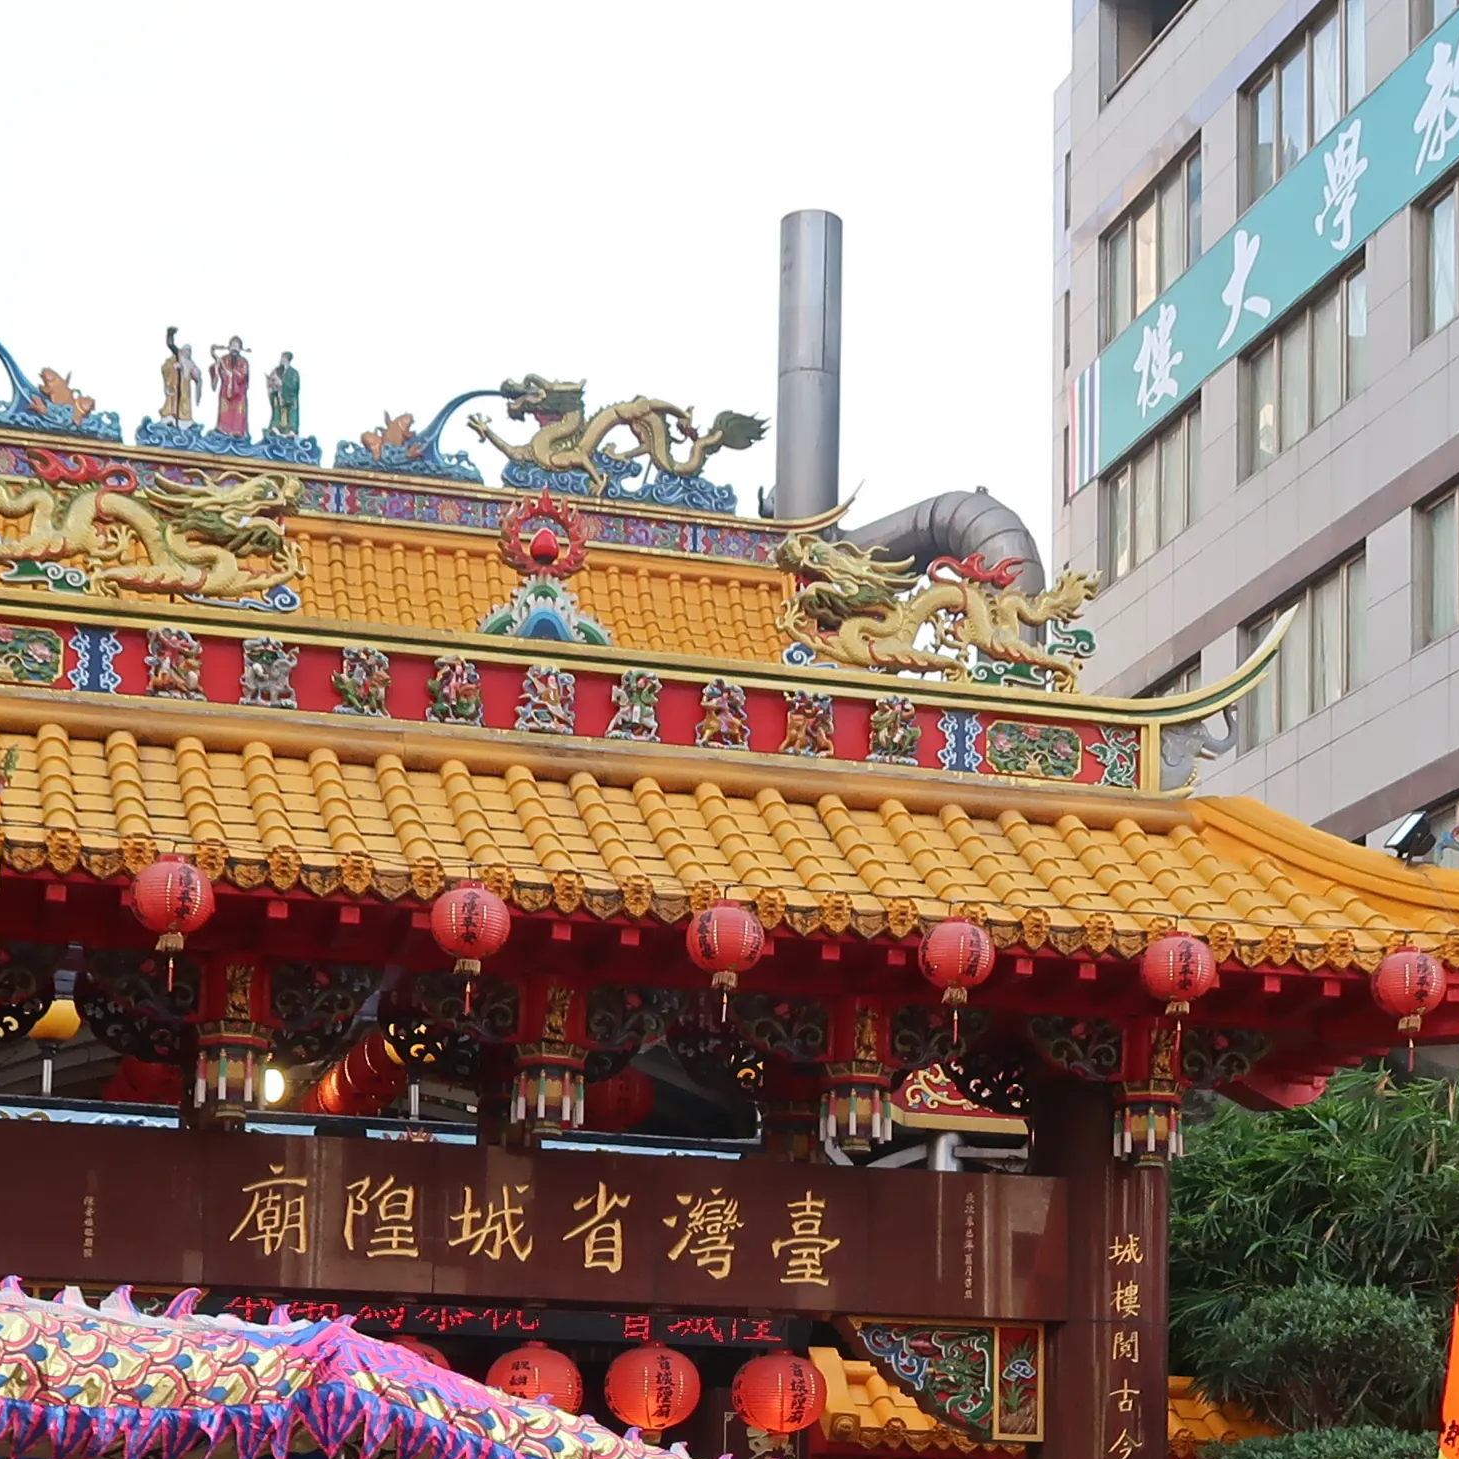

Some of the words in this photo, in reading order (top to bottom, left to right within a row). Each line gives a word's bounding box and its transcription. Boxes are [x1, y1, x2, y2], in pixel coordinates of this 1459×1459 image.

[228, 1164, 843, 1288] 臺灣省城隍廟
